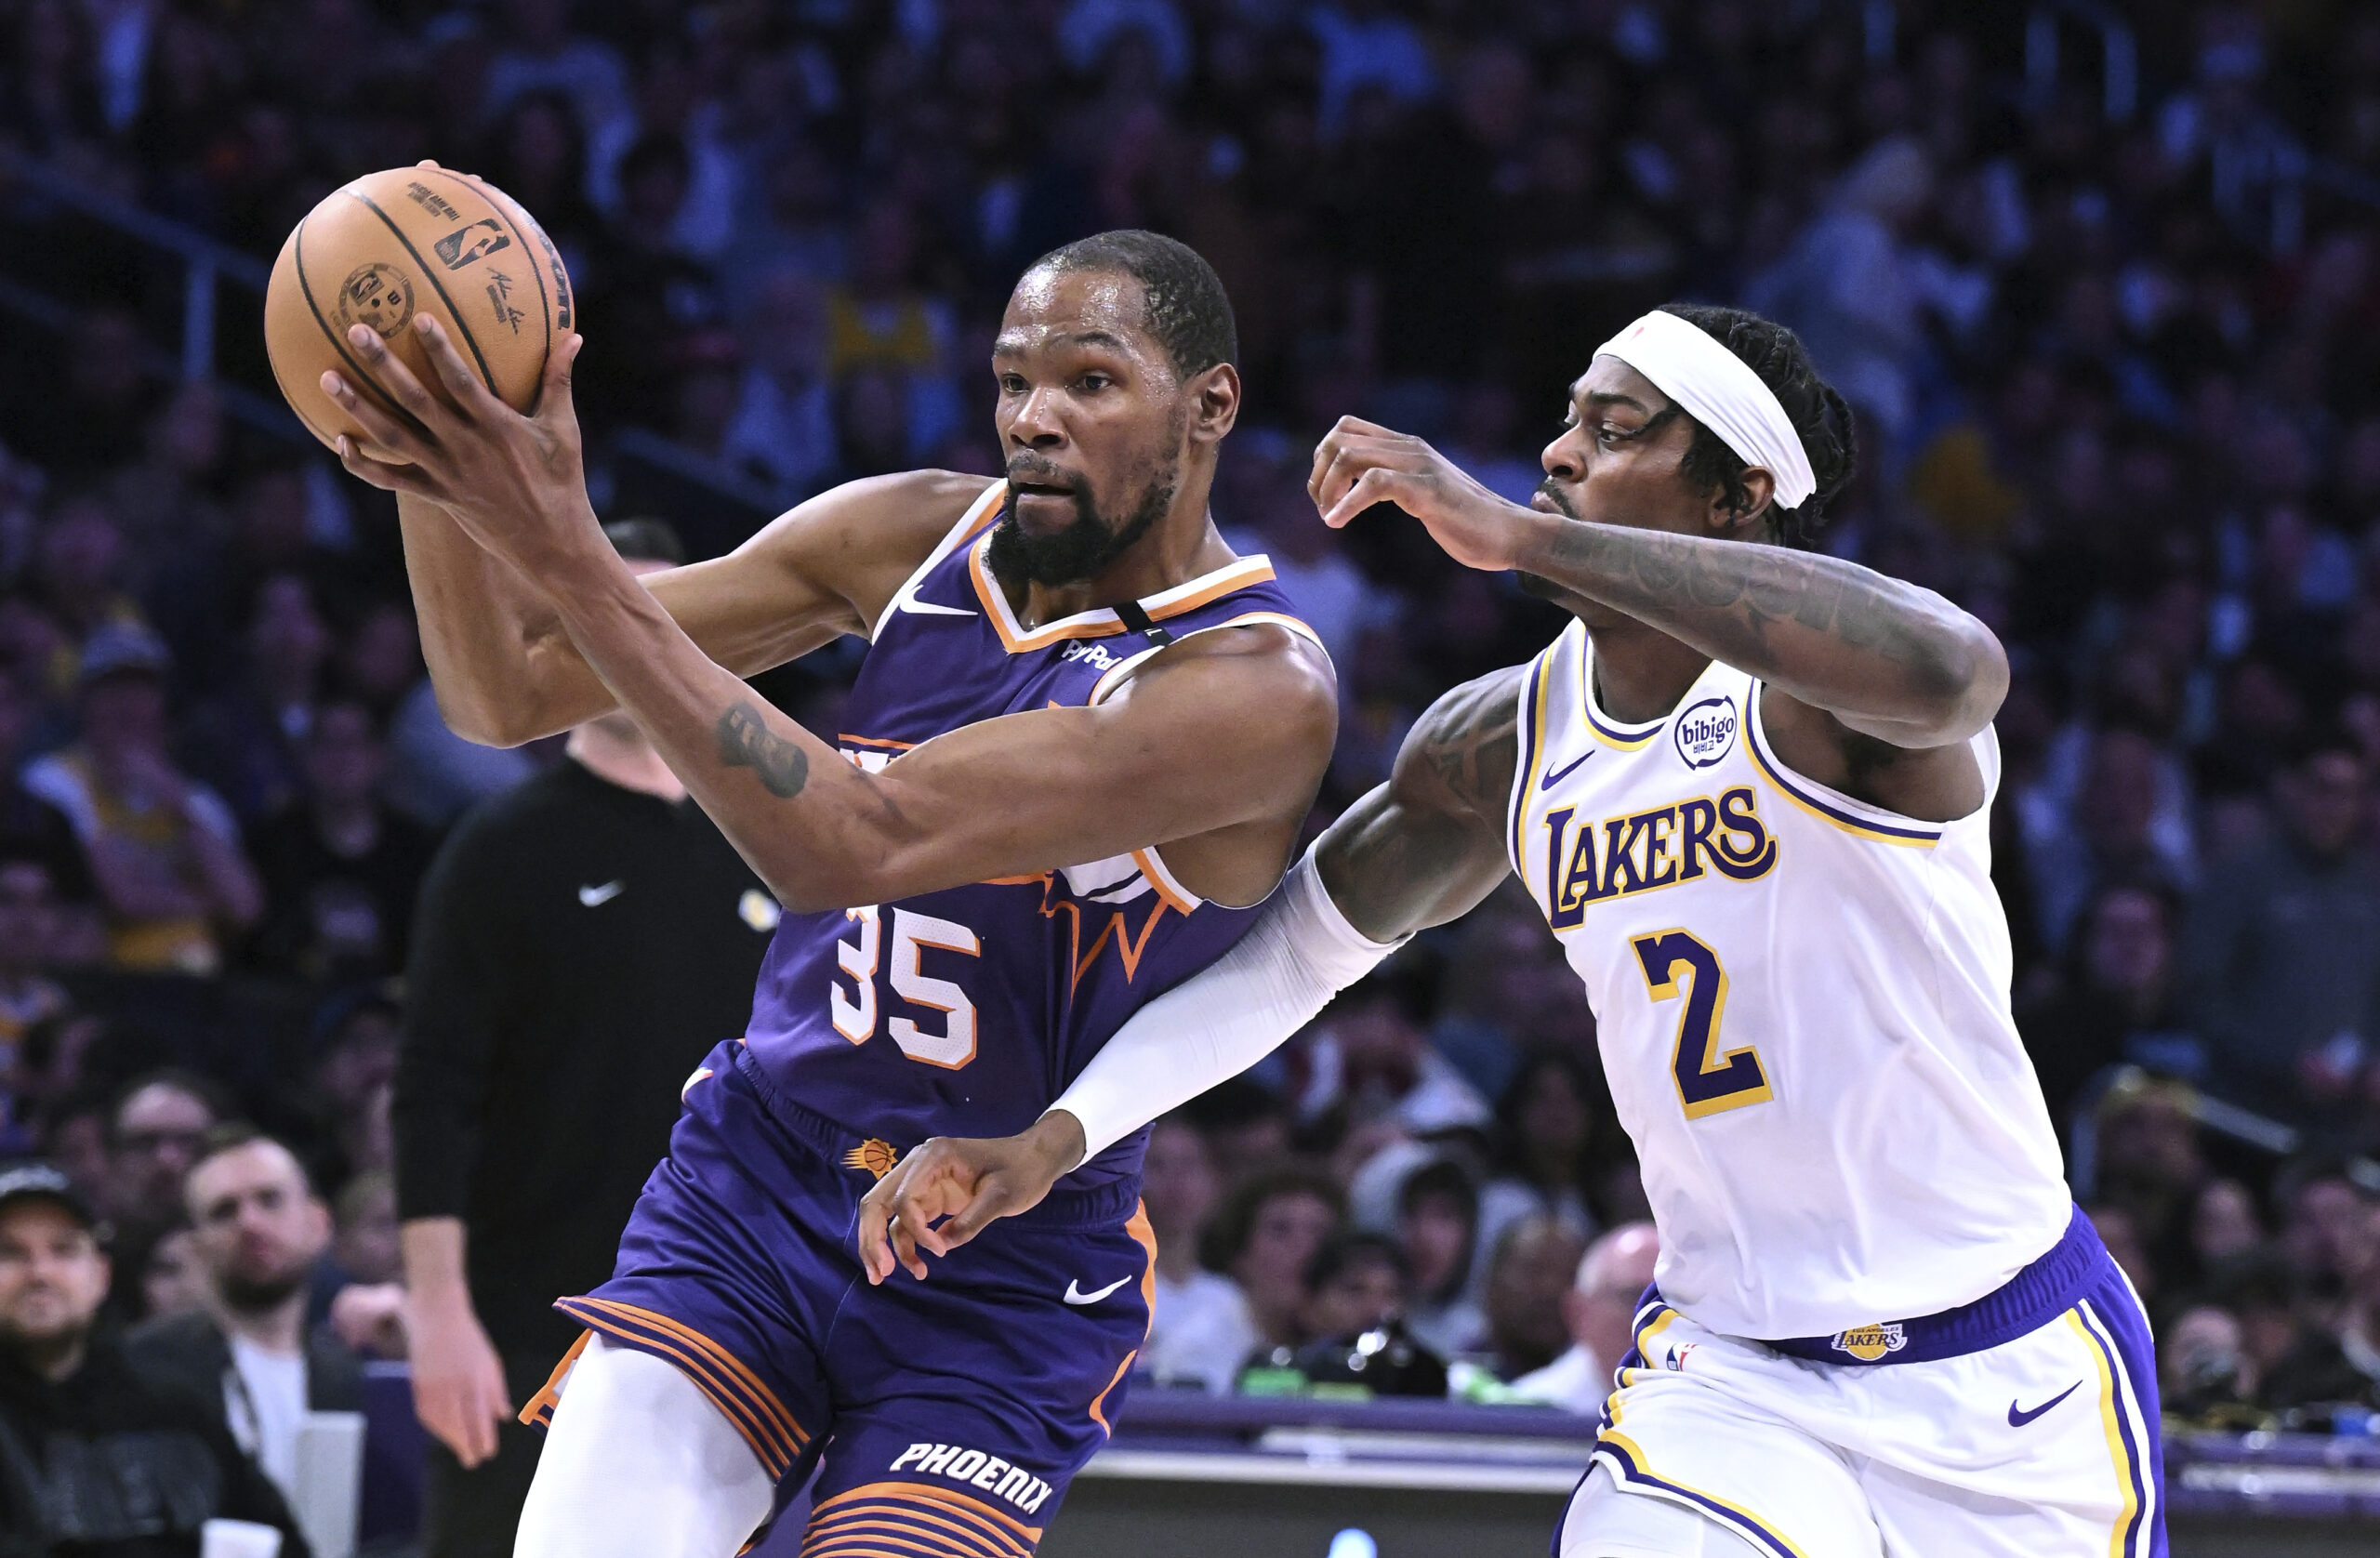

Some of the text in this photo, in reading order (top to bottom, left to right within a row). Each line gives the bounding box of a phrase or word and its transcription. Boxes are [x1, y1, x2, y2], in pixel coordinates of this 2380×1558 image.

[1682, 716, 1735, 745] bibigo
[1542, 785, 1779, 931] LAKERS
[830, 904, 981, 1071] 35
[1629, 927, 1774, 1120] 2
[1836, 1331, 1904, 1350] LAKERS
[890, 1444, 1052, 1514] PHOENIX
